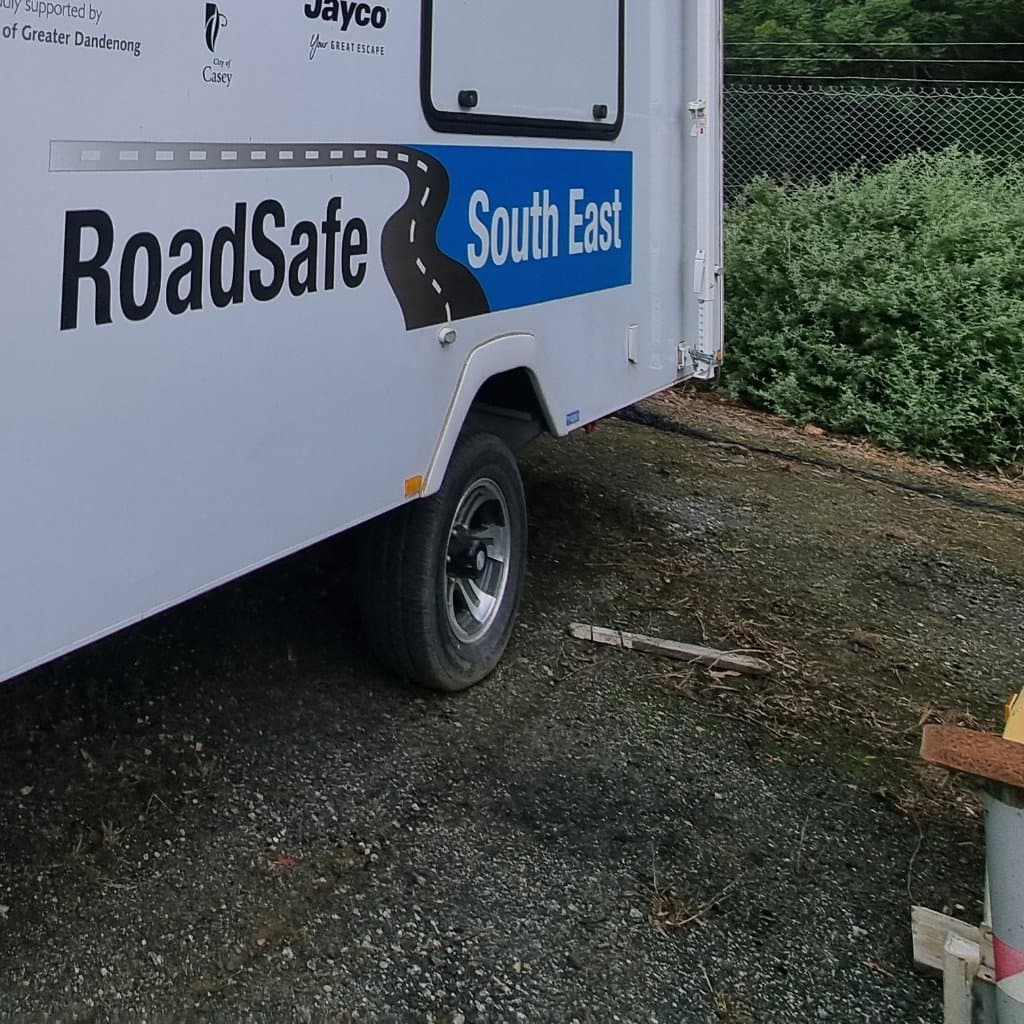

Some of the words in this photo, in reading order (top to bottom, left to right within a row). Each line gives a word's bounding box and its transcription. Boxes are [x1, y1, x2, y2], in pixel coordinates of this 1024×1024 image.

[89, 4, 103, 25] by
[2, 22, 19, 39] of
[22, 25, 71, 46] Greater
[74, 30, 141, 57] Dandenong
[309, 33, 329, 60] Your
[330, 40, 355, 53] GREAT
[356, 43, 385, 56] ESCAPE
[202, 65, 233, 87] Casey
[213, 58, 225, 68] City
[225, 59, 232, 67] of
[466, 189, 559, 269] South
[567, 187, 622, 256] East
[60, 196, 368, 331] RoadSafe
